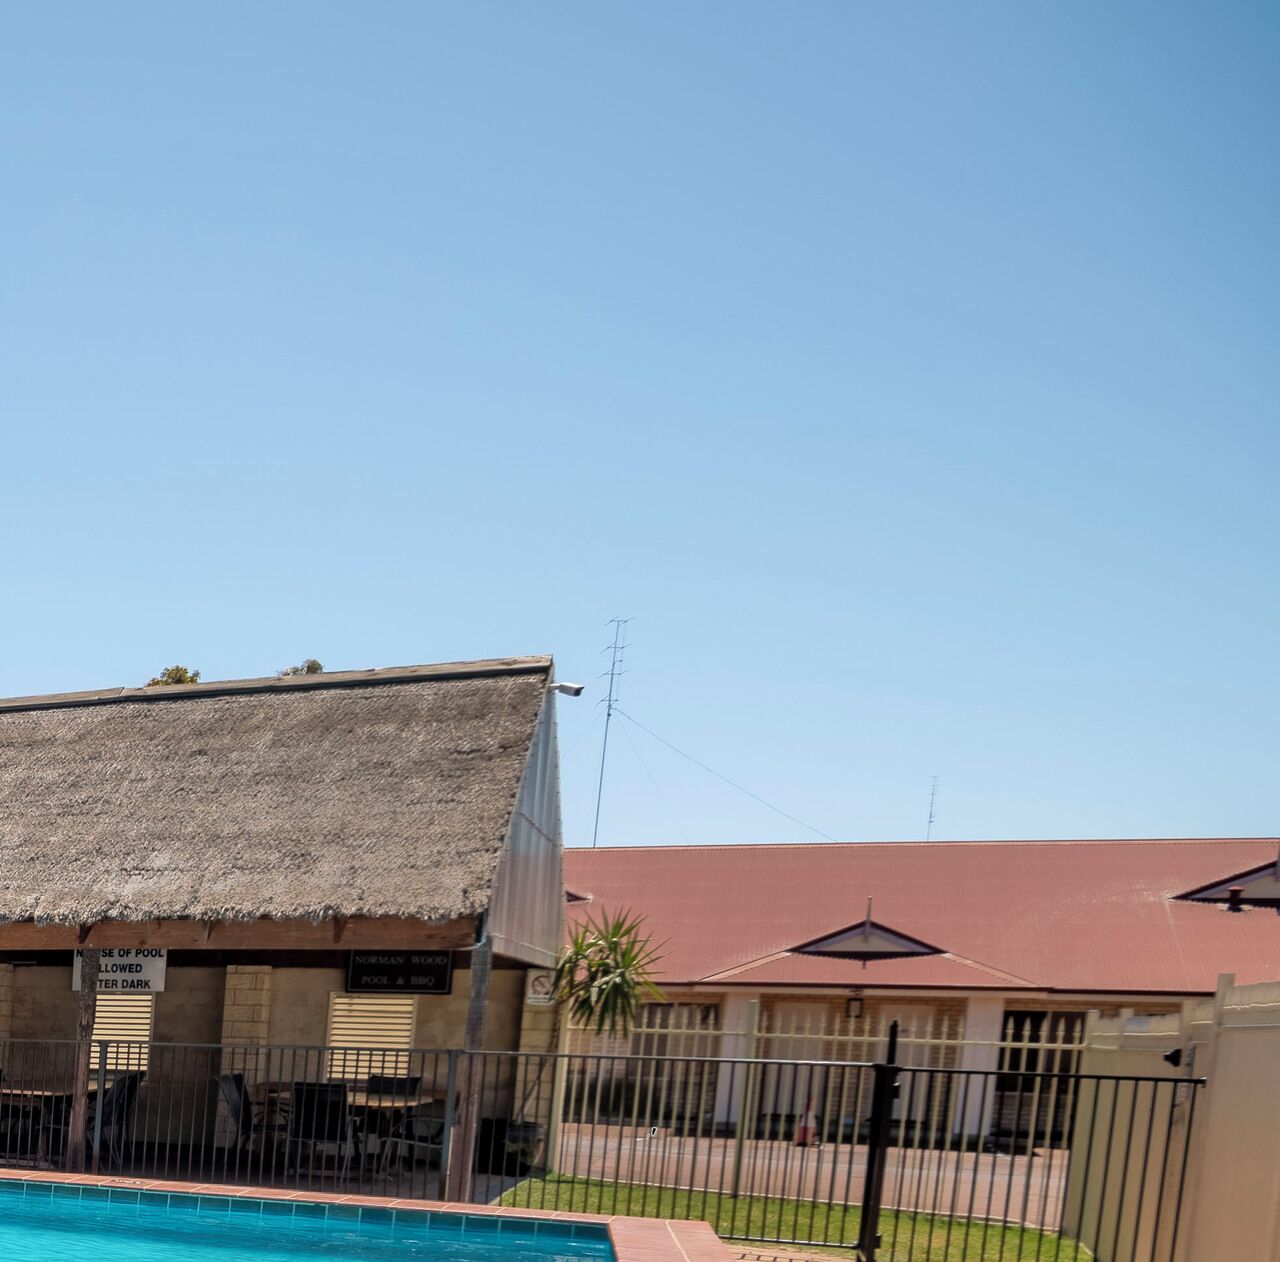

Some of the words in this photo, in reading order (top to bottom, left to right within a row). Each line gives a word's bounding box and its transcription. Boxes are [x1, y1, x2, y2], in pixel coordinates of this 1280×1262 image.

[101, 949, 115, 957] SE
[118, 949, 132, 957] OF
[136, 949, 164, 958] POOL
[355, 955, 404, 965] NORMAN
[411, 956, 447, 965] WOOD
[99, 963, 143, 973] LLOWED
[98, 979, 118, 989] TER
[121, 979, 151, 989] DARK
[361, 975, 390, 984] POOL
[396, 976, 405, 984] &
[411, 976, 435, 986] BBQ
